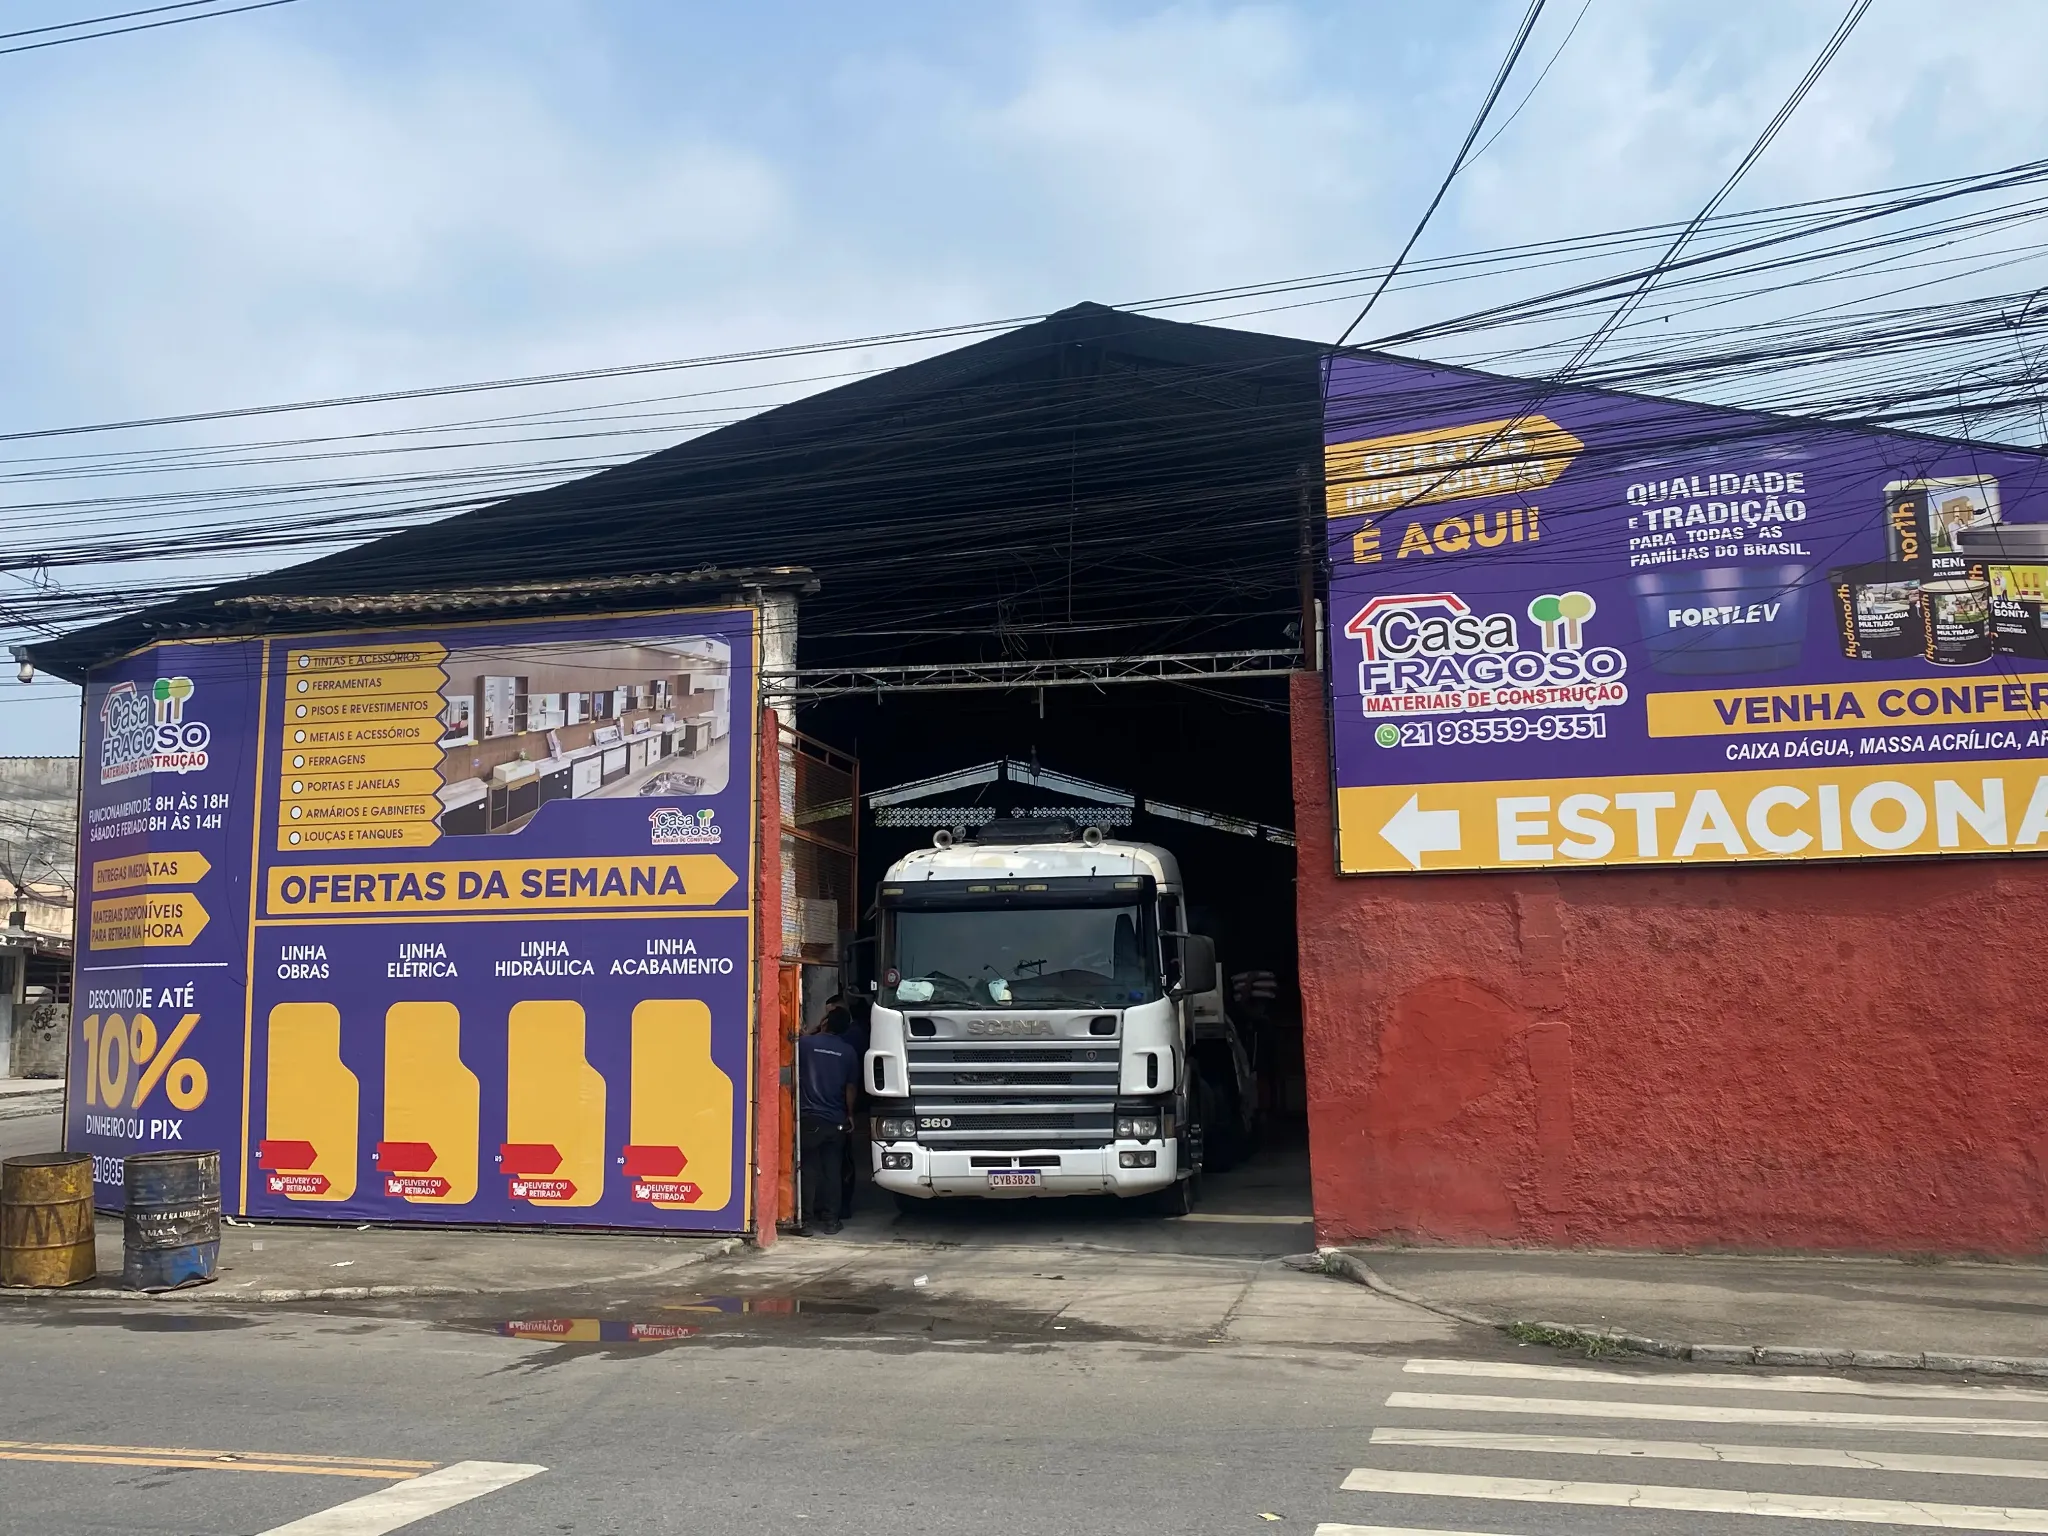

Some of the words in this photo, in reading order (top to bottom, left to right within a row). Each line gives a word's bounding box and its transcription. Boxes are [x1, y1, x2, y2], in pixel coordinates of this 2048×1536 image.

[1362, 430, 1526, 476] OFERTAS
[1626, 472, 1805, 506] QUALIDADE
[1643, 495, 1806, 531] TRADIÇÃO
[1353, 519, 1381, 564] É
[1397, 506, 1540, 560] AQUI!
[1629, 532, 1676, 550] PARA
[1686, 527, 1743, 542] TODAS
[1759, 525, 1782, 538] AS
[1631, 546, 1709, 567] FAMÍLIAS
[1715, 544, 1738, 557] DO
[1744, 543, 1810, 556] BRASIL.
[1993, 601, 2021, 610] CASA
[1994, 609, 2030, 618] BONITA
[1669, 603, 1780, 628] FORTLEV
[1837, 584, 1860, 657] Hydronorth
[1858, 620, 1894, 628] MULTIUSO
[1380, 611, 1514, 654] Casa
[1921, 594, 1938, 660] Hydronorth
[314, 656, 345, 667] TINTAS
[349, 655, 353, 665] E
[357, 651, 420, 665] ACESSÓRIOS
[1362, 650, 1623, 691] FRAGOSO
[312, 678, 382, 690] FERRAMENTAS
[1367, 694, 1461, 712] MATERIAIS
[1468, 693, 1490, 707] DE
[1497, 684, 1623, 705] CONSTRUÇÃO
[109, 695, 149, 731] Casa
[311, 704, 338, 716] PISOS
[342, 704, 346, 713] E
[350, 700, 428, 713] REVESTIMENTOS
[1714, 691, 1864, 726] VENHA
[310, 731, 344, 742] METAIS
[348, 731, 352, 740] E
[356, 726, 420, 740] ACESSÓRIOS
[1402, 722, 1433, 746] 21
[1438, 714, 1606, 744] 98559-9351
[102, 724, 208, 764] FRAGOSO
[1725, 742, 1781, 761] CAIXA
[1784, 735, 1855, 758] DÁGUA,
[1859, 732, 1926, 754] MASSA
[1928, 728, 2021, 752] ACRÍLICA,
[102, 762, 129, 780] MATERIAIS
[130, 760, 138, 773] DE
[139, 752, 205, 770] CONSTRUÇÃO
[309, 755, 365, 766] FERRAGENS
[307, 781, 344, 792] PORTAS
[348, 781, 352, 790] E
[356, 779, 400, 789] JANELAS
[89, 799, 141, 823] FUNCIONAMENTO
[143, 797, 151, 812] DE
[155, 796, 174, 811] 8H
[178, 791, 197, 810] ÀS
[203, 793, 229, 809] 18H
[306, 805, 359, 818] ARMÁRIOS
[363, 807, 367, 816] E
[371, 805, 425, 816] GABINETES
[90, 820, 115, 842] SÁBADO
[121, 818, 148, 836] FERIADO
[148, 816, 167, 831] 8H
[171, 811, 190, 830] ÀS
[196, 814, 222, 829] 14H
[658, 813, 693, 826] Casa
[305, 830, 345, 843] LOUÇAS
[349, 830, 353, 840] E
[357, 829, 403, 840] TANQUES
[652, 827, 720, 837] FRAGOSO
[97, 866, 127, 883] ENTREGAS
[128, 861, 178, 879] IMEDIATAS
[280, 871, 446, 904] OFERTAS
[458, 871, 509, 901] DA
[521, 865, 686, 898] SEMANA
[93, 907, 122, 924] MATERIAIS
[124, 900, 183, 921] DISPONÍVEIS
[92, 927, 107, 942] PARA
[108, 925, 130, 942] RETIRAR
[132, 925, 141, 939] NA
[143, 923, 184, 938] HORA
[281, 945, 327, 961] LINHA
[399, 943, 447, 959] LINHA
[521, 941, 569, 957] LINHA
[647, 939, 697, 955] LINHA
[277, 963, 330, 980] OBRAS
[388, 958, 458, 978] ELÉTRICA
[495, 956, 595, 977] HIDRÁULICA
[610, 957, 733, 976] ACABAMENTO
[89, 988, 134, 1009] DESCONTO
[136, 987, 152, 1008] DE
[158, 980, 194, 1008] ATÉ
[967, 1019, 1055, 1036] SCANIA
[83, 1013, 208, 1112] 10%
[86, 1115, 125, 1138] DINHEIRO
[127, 1118, 144, 1139] OU
[150, 1119, 183, 1140] PIX
[921, 1116, 952, 1128] 360
[282, 1177, 309, 1185] DELIVERY
[311, 1177, 322, 1185] OU
[286, 1184, 316, 1192] RETIRADA
[399, 1179, 429, 1187] DELIVERY
[524, 1182, 554, 1190] DELIVERY
[556, 1182, 567, 1190] OU
[647, 1184, 677, 1192] DELIVERY
[993, 1175, 1036, 1185] CYB3B28
[404, 1187, 435, 1195] RETIRADA
[529, 1190, 561, 1198] RETIRADA
[652, 1192, 685, 1200] RETIRADA
